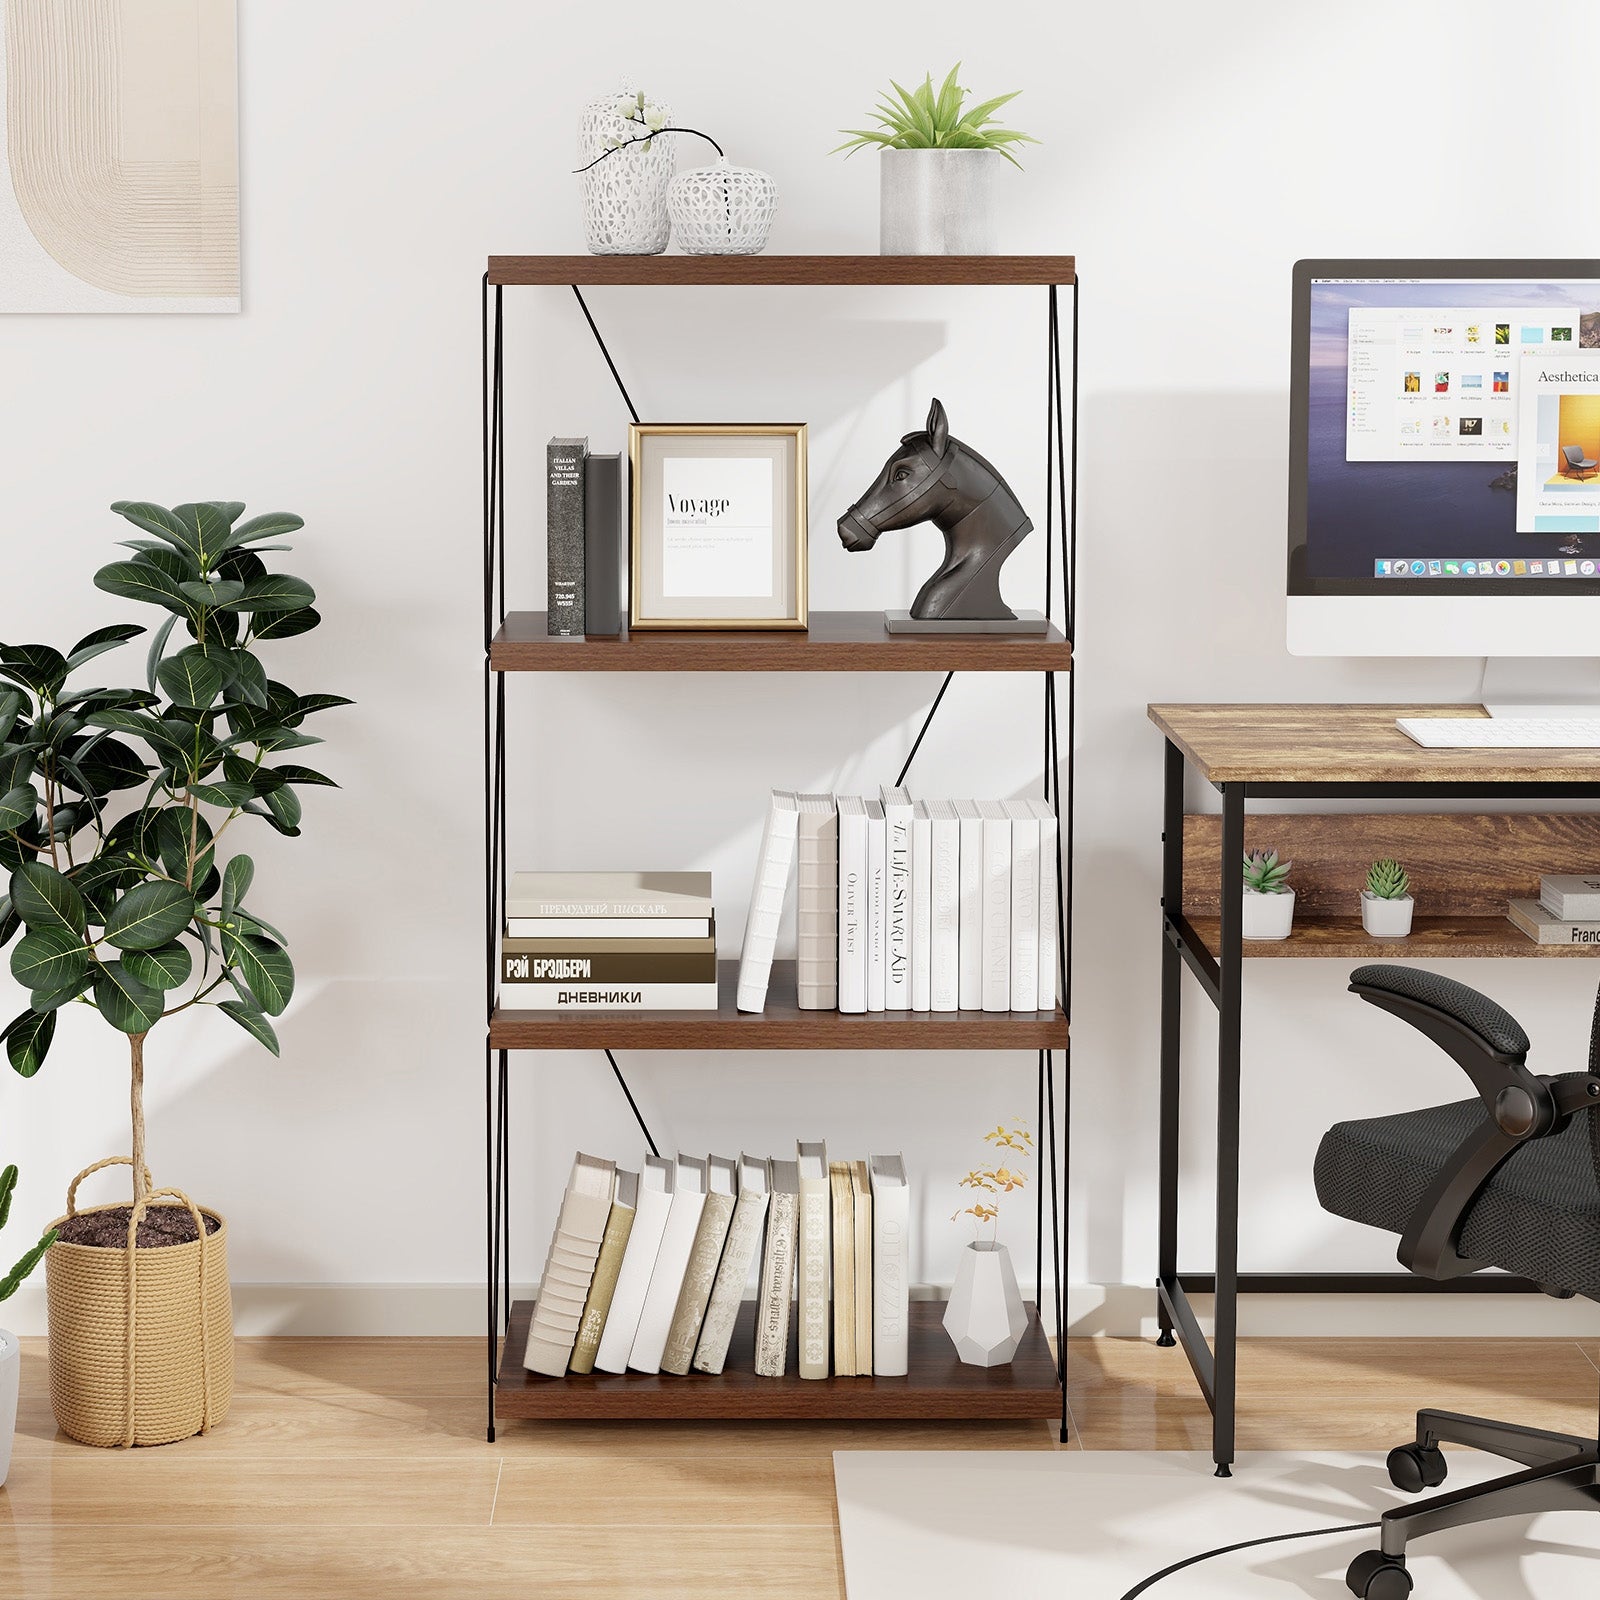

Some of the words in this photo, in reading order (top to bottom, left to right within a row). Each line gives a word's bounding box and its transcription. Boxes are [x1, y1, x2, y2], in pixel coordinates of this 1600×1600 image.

[1538, 370, 1599, 383] Aesthetica
[668, 493, 730, 517] Voyage
[539, 903, 609, 915] ПРЕМУДРЫЙ
[613, 904, 668, 915] ПИСКАРЬ
[991, 911, 1007, 988] CHANEL
[506, 955, 529, 978] РЭЙ
[533, 958, 591, 979] БРЭДБЕРИ
[557, 991, 642, 1005] ДНЕВНИКИ
